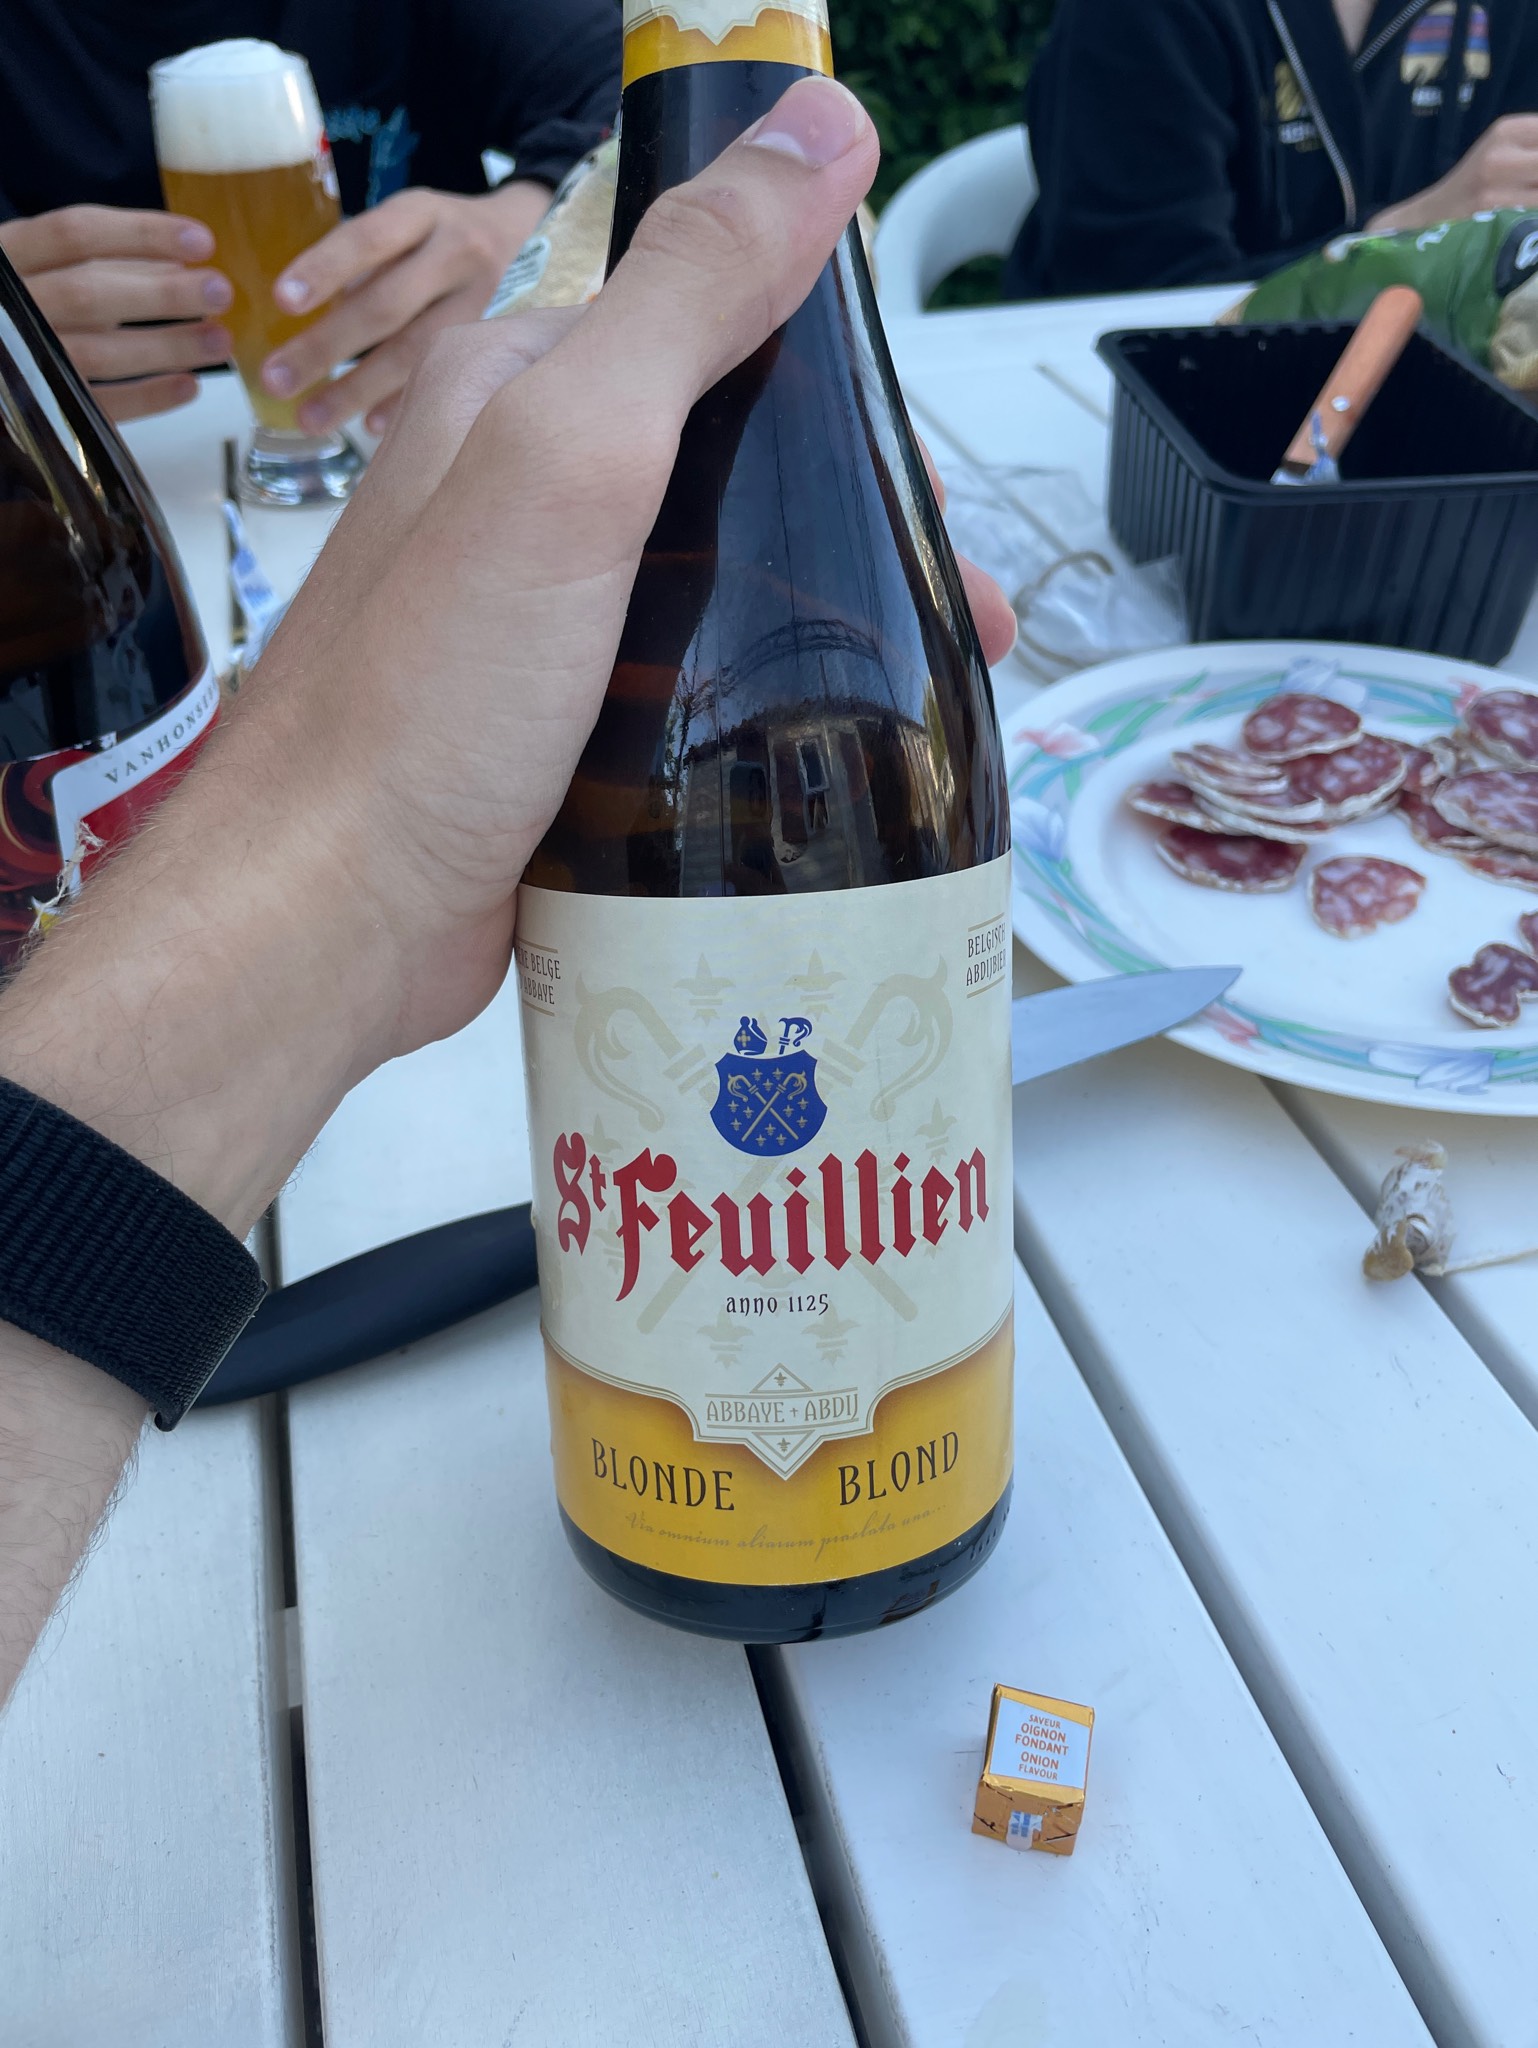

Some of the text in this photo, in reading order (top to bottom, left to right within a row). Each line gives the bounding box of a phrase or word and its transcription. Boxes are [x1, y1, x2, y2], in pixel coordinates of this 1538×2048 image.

[968, 922, 1006, 958] BELGISCH
[531, 953, 561, 981] BELGE
[553, 1132, 990, 1302] St Feuillien
[726, 1293, 829, 1317] anno 1125
[706, 1393, 859, 1423] ABBAYE ABDIJ
[591, 1431, 959, 1512] BLONDE BLOND
[1021, 1723, 1067, 1744] OIGNON
[1028, 1714, 1061, 1729] SAVEUR
[1014, 1734, 1069, 1756] FONDANT
[1018, 1763, 1058, 1780] FLAVOUR
[1020, 1751, 1059, 1770] ONION
